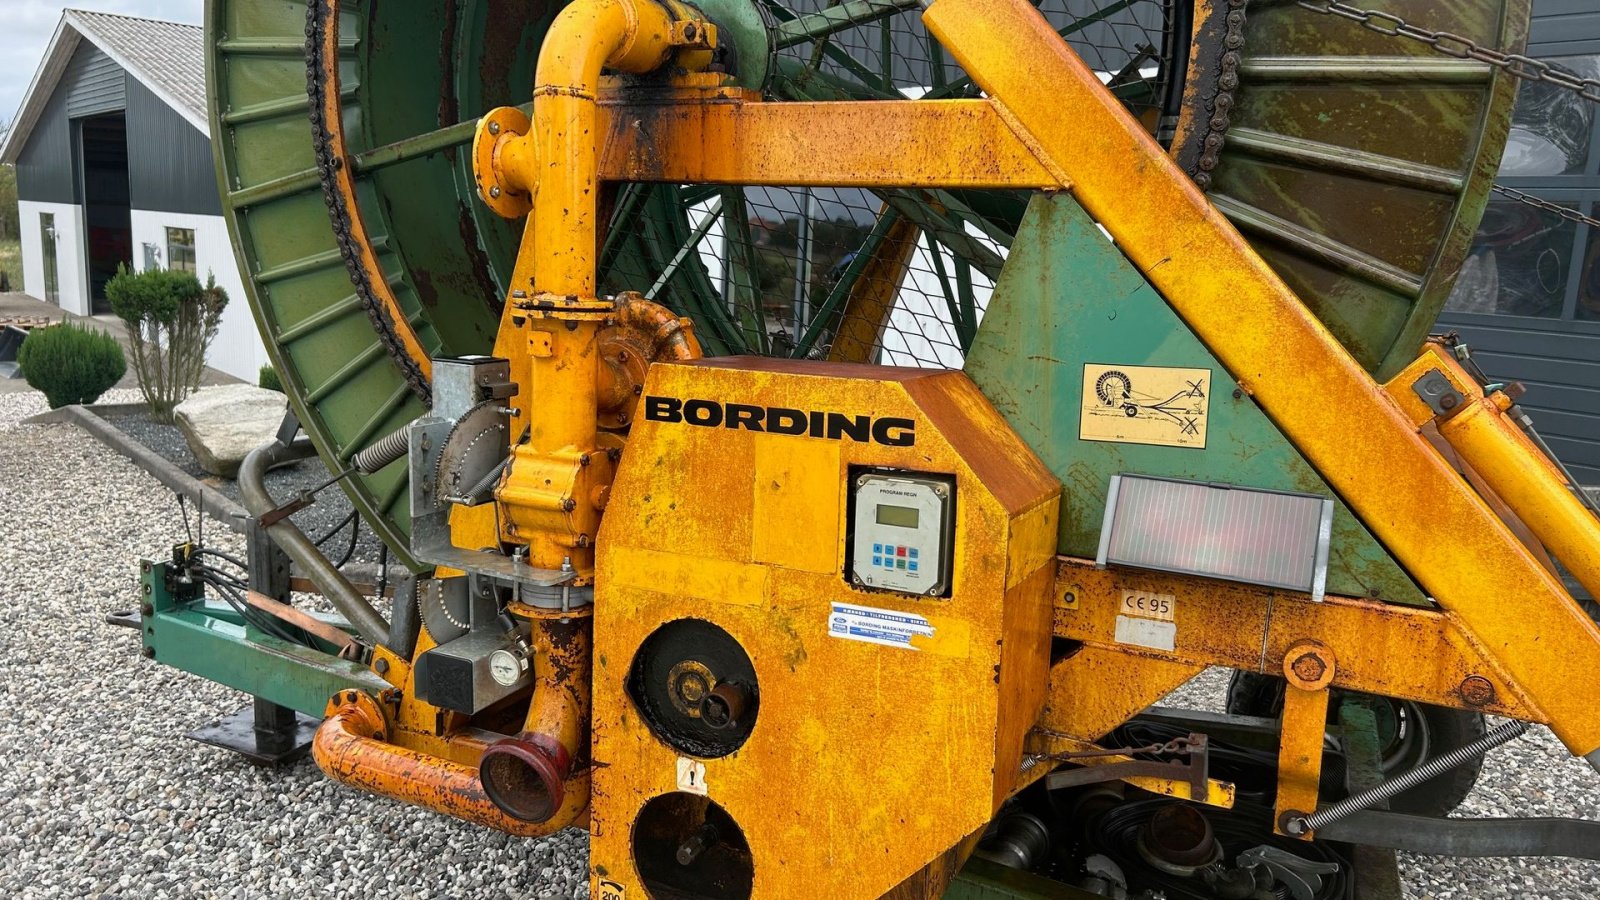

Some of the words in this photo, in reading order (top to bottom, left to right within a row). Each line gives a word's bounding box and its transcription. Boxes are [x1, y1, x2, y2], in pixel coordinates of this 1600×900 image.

[645, 395, 916, 446] BORDING
[1126, 595, 1145, 610] CE
[1150, 598, 1169, 613] 95
